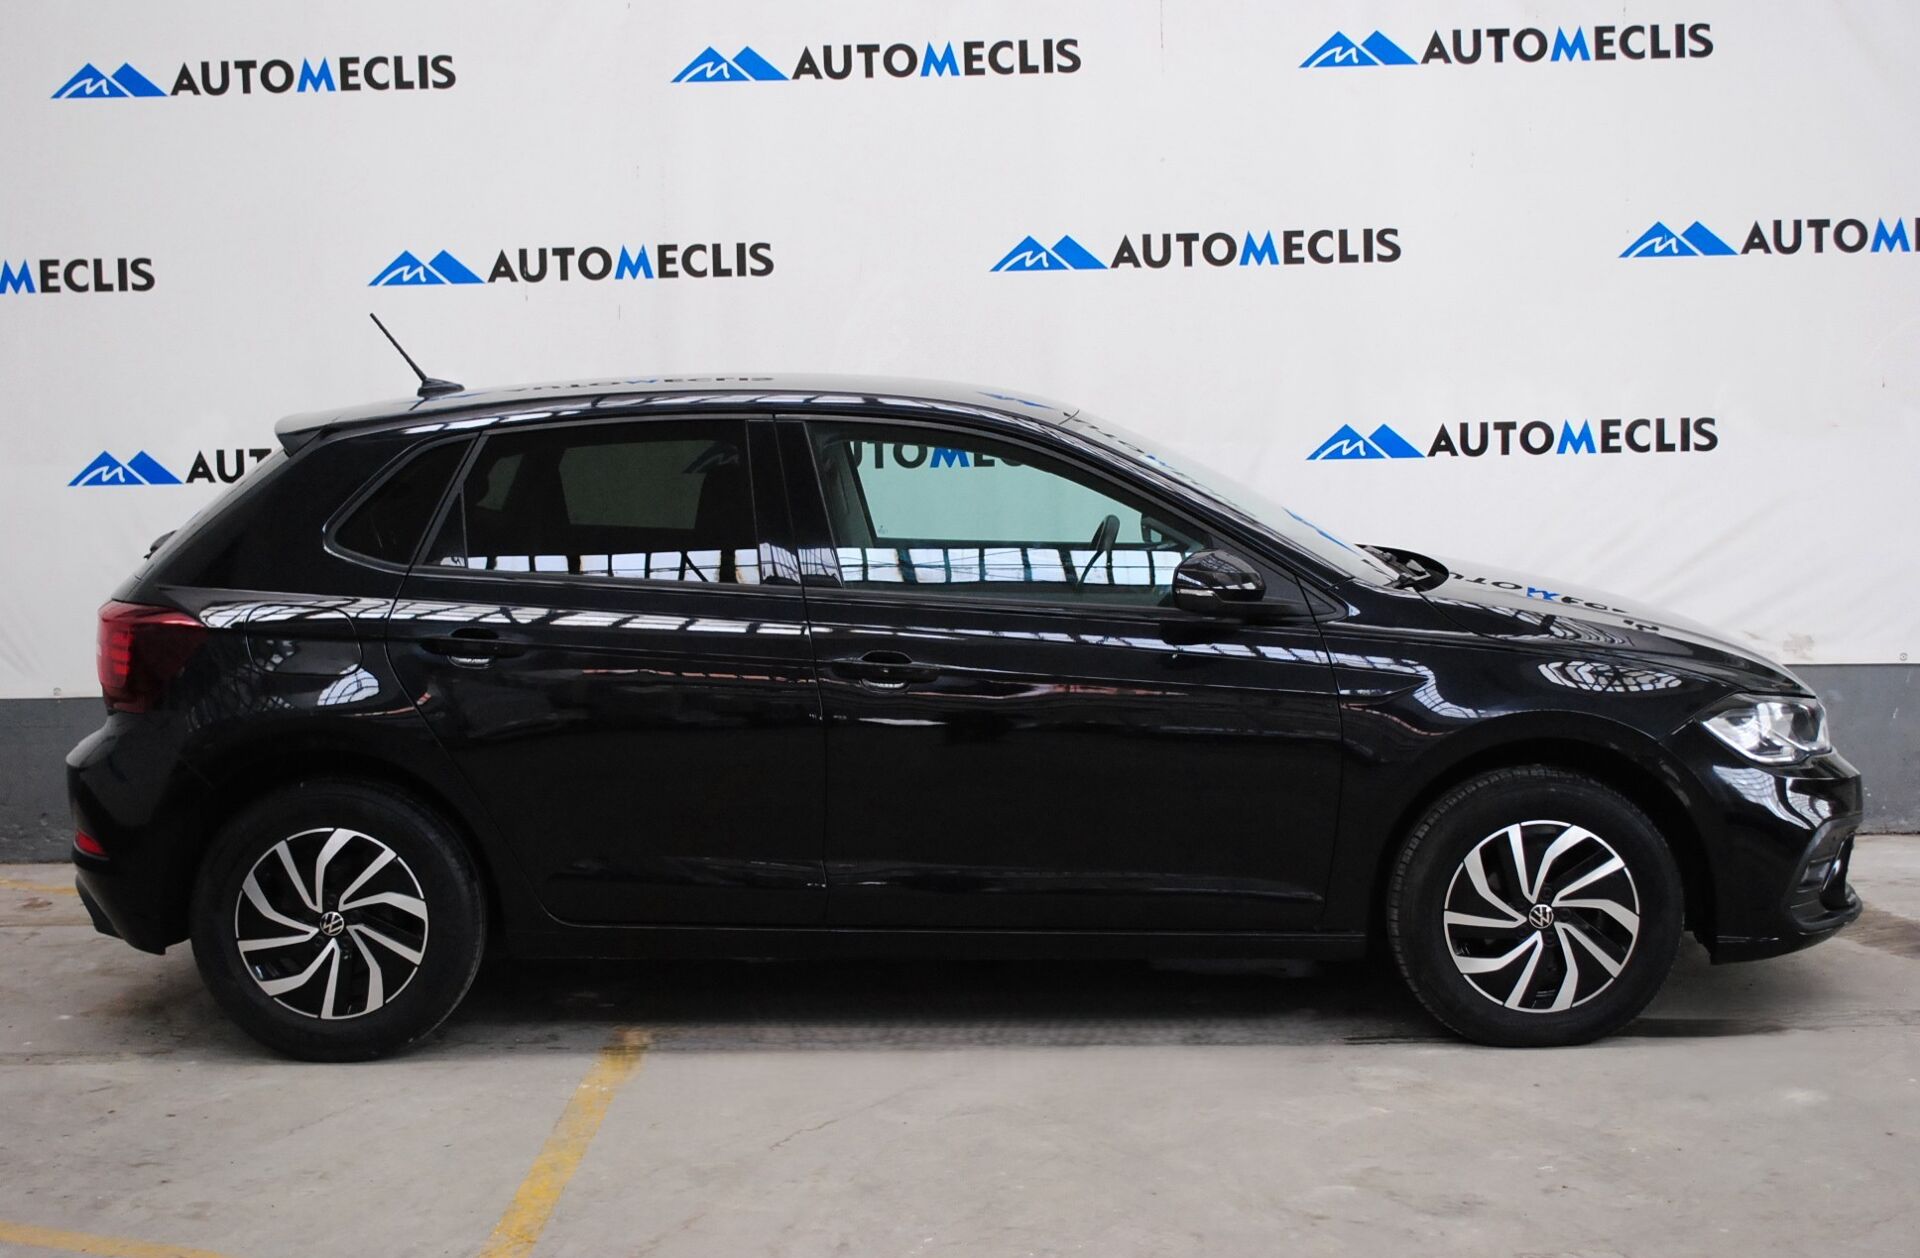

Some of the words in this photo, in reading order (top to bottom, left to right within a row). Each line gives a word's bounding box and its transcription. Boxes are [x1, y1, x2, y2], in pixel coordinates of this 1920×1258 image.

[791, 38, 1082, 81] AUTOMECLIS
[1421, 22, 1714, 65] AUTOMECLIS
[170, 54, 456, 97] AUTOMECLIS
[1110, 228, 1402, 270] AUTOMECLIS
[1740, 217, 1920, 256] AUTOM
[487, 242, 774, 284] AUTOMECLIS
[1427, 417, 1719, 459] AUTOMECLIS
